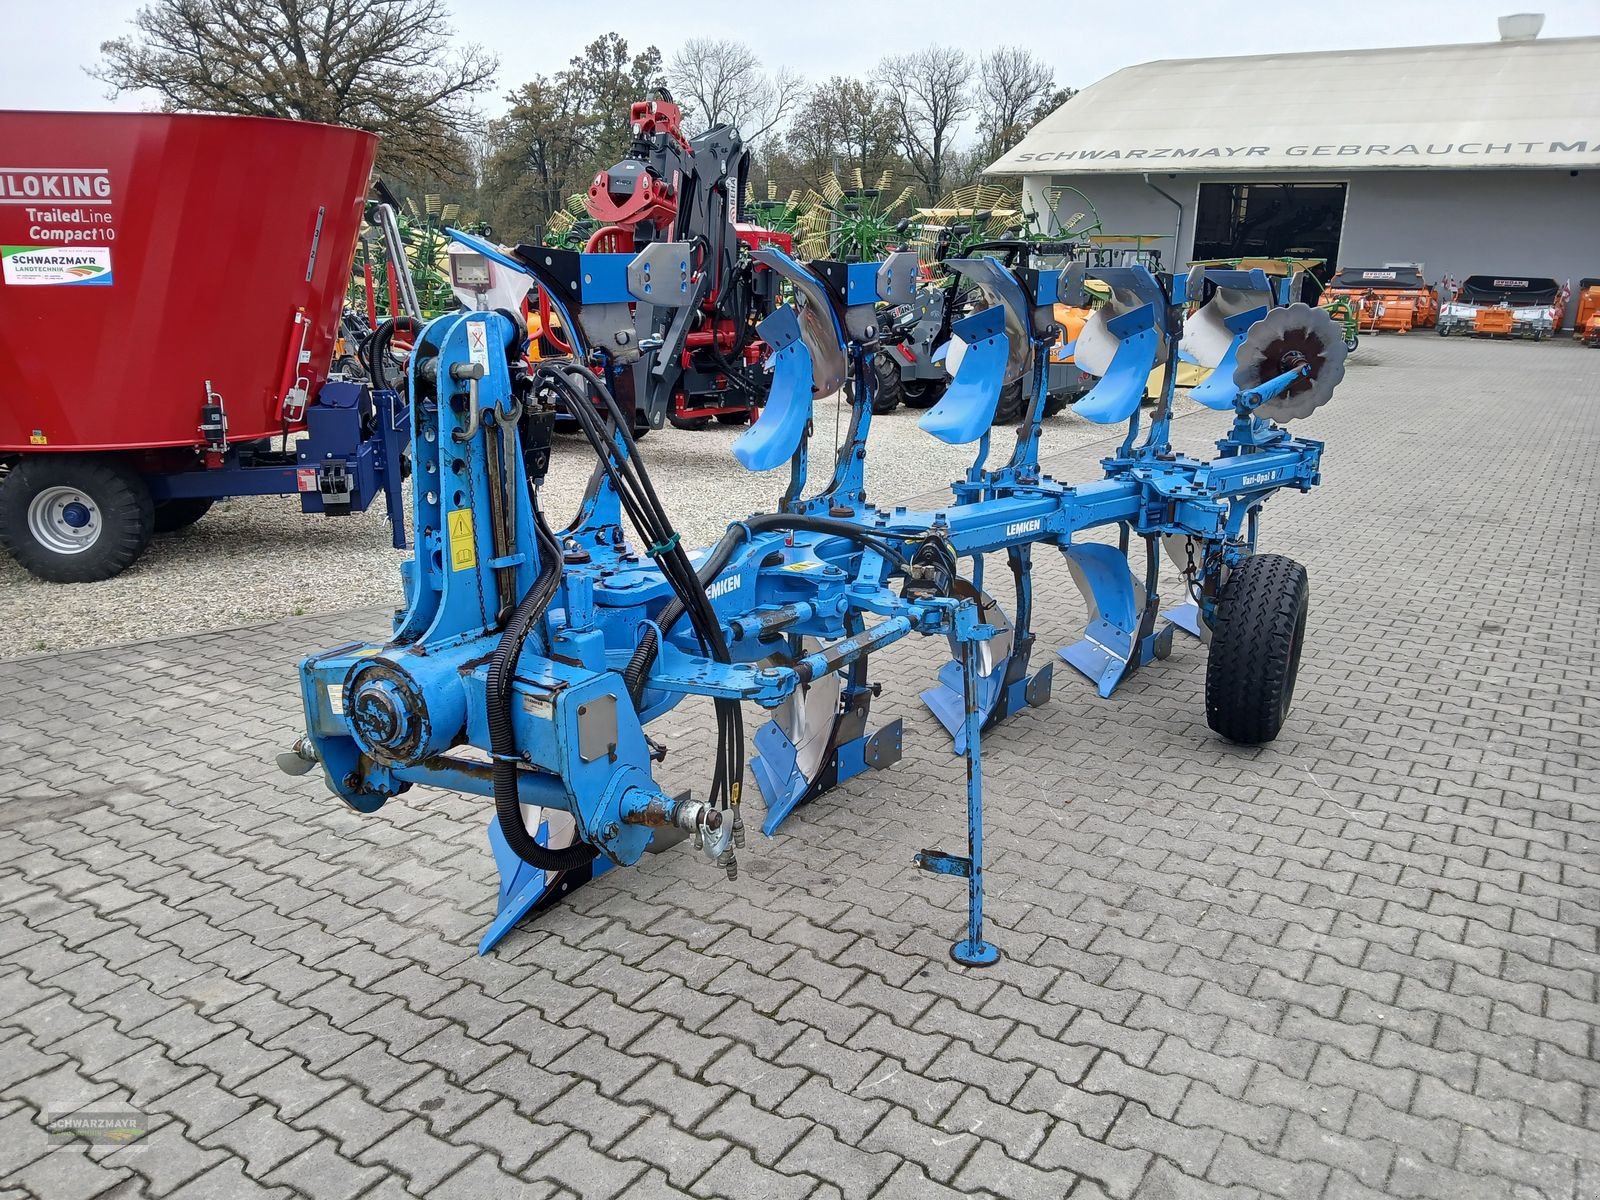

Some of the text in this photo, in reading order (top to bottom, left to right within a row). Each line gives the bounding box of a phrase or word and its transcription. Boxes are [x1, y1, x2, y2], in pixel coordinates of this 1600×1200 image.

[1014, 145, 1270, 162] SCHWARZMAYR
[25, 207, 112, 223] TrailedLine
[29, 225, 115, 244] Compact10
[12, 255, 96, 265] SCHWARZMAYR
[1006, 519, 1041, 537] LEMKEN
[705, 573, 741, 600] EMKEN
